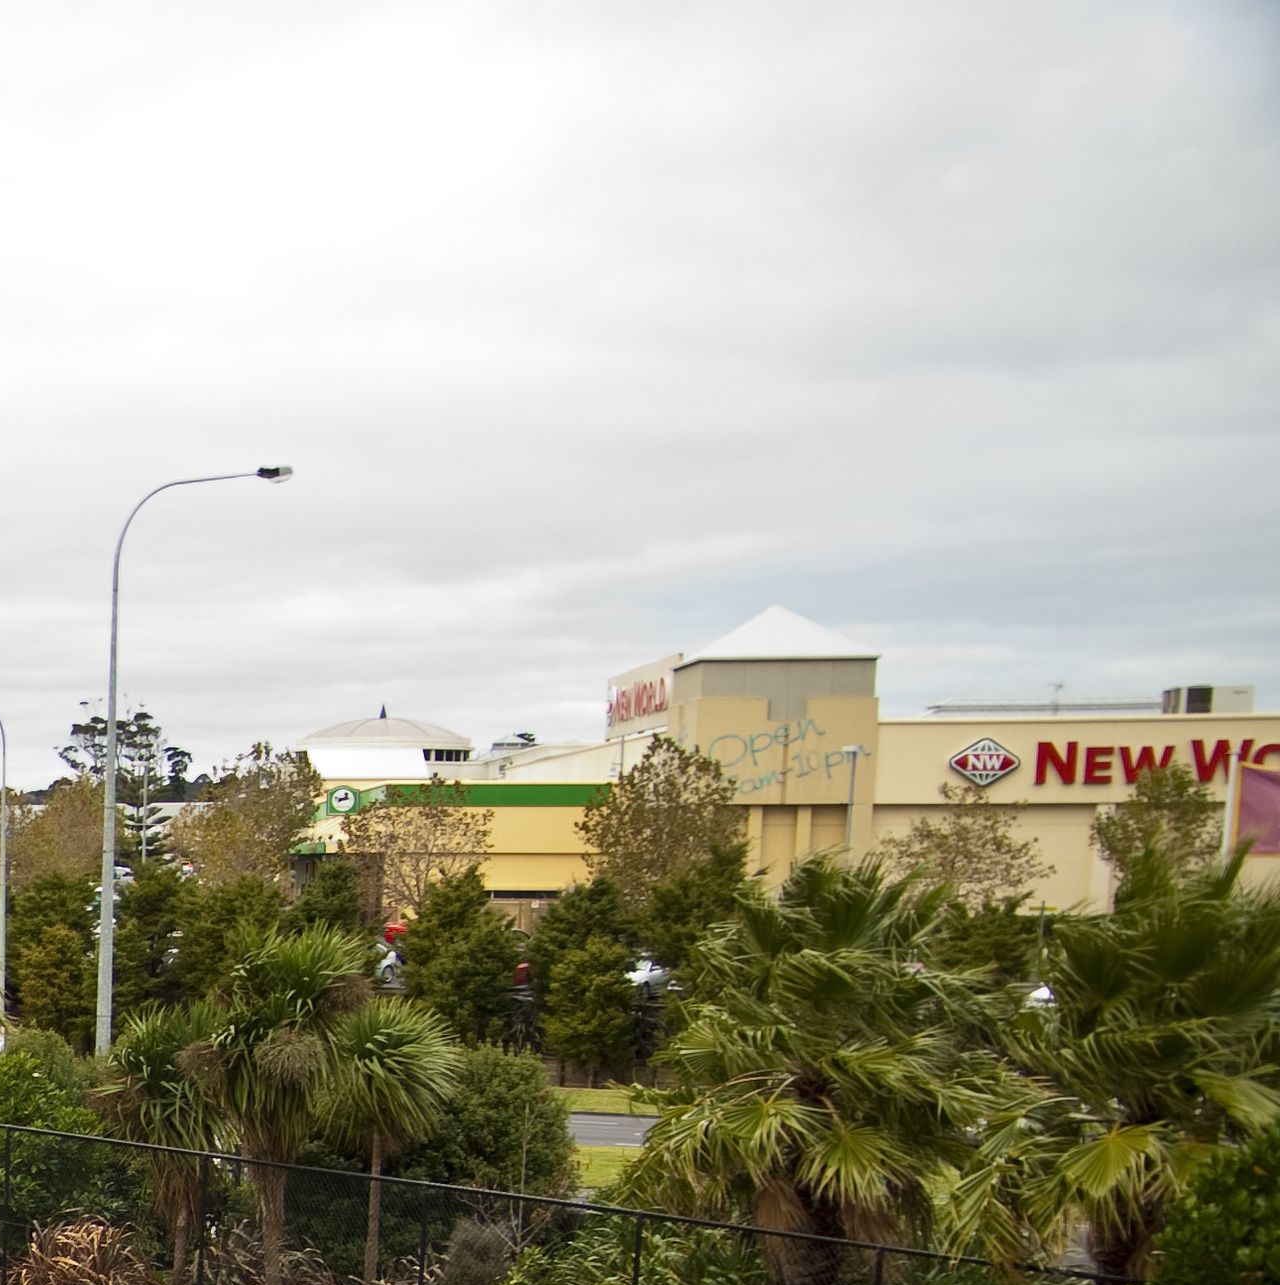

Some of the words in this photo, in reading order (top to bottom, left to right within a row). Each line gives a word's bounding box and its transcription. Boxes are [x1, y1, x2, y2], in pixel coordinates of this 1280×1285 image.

[708, 719, 825, 768] Open
[966, 754, 1006, 770] NW
[1034, 740, 1175, 785] NEW
